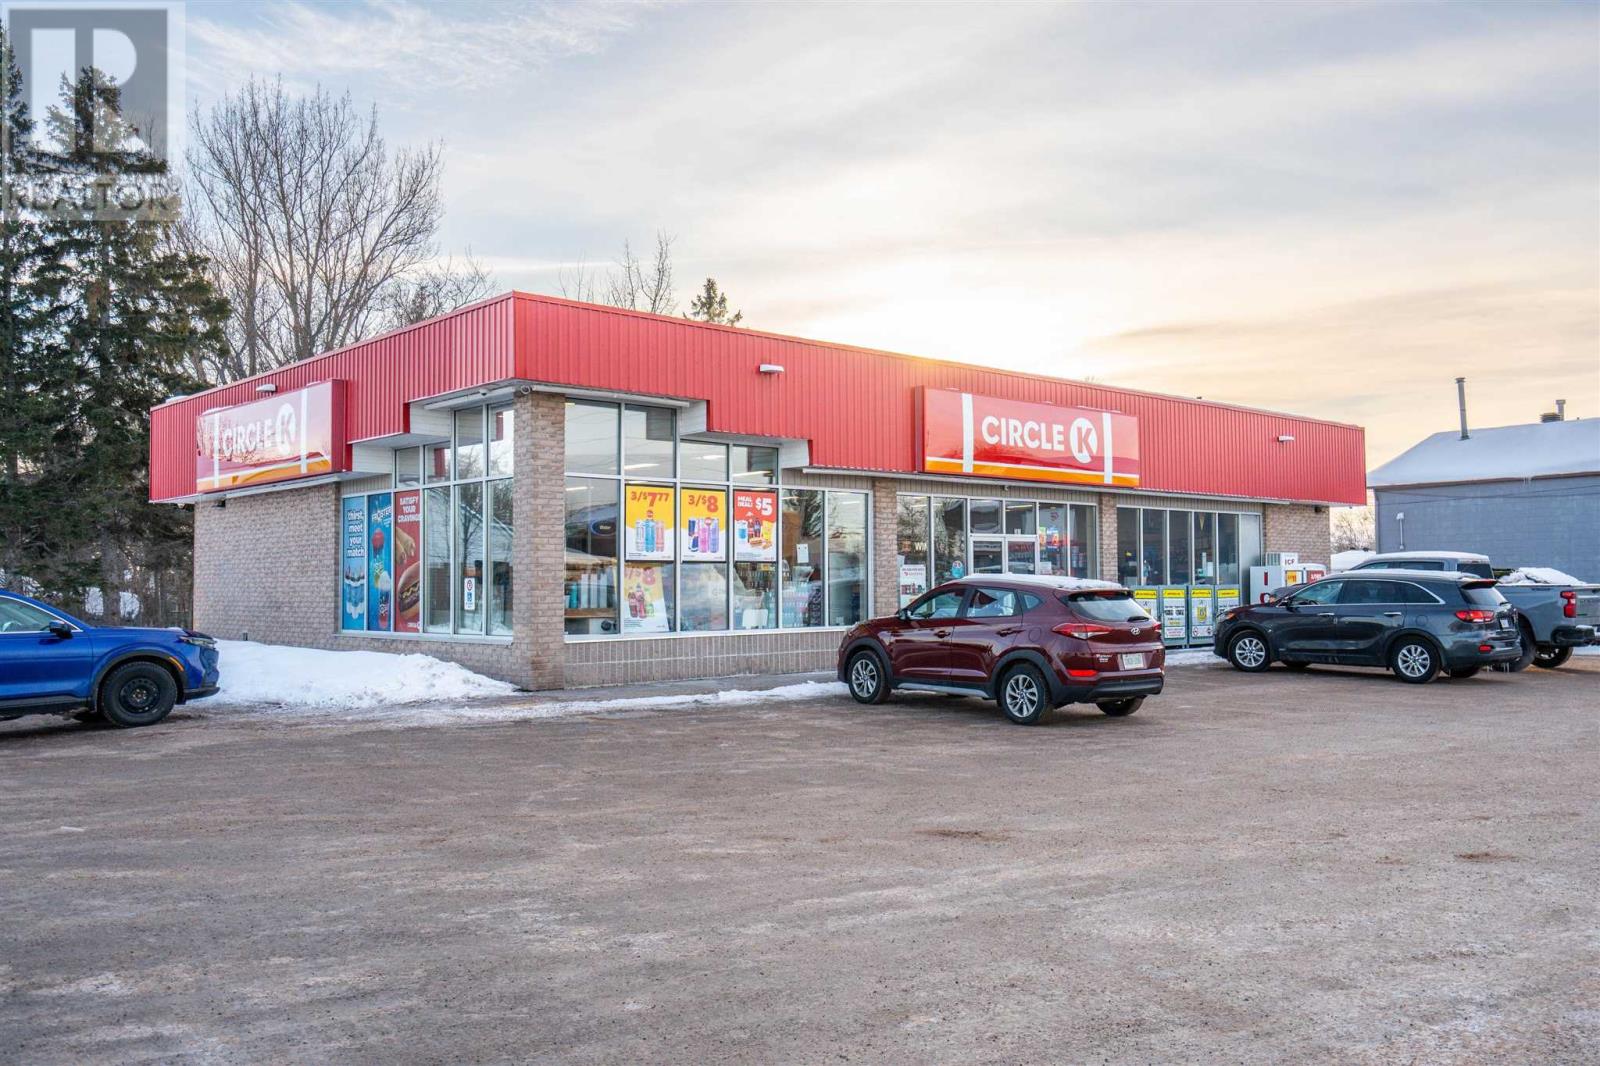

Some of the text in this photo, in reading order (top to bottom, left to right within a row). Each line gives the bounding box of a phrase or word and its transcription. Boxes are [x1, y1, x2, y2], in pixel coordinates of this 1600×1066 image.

[222, 418, 273, 457] CIRCLE
[981, 415, 1097, 460] CIRCLE K
[402, 505, 416, 514] YOUR
[688, 495, 719, 513] 3/$8
[755, 497, 773, 516] $5
[349, 537, 362, 546] your
[347, 548, 365, 557] match
